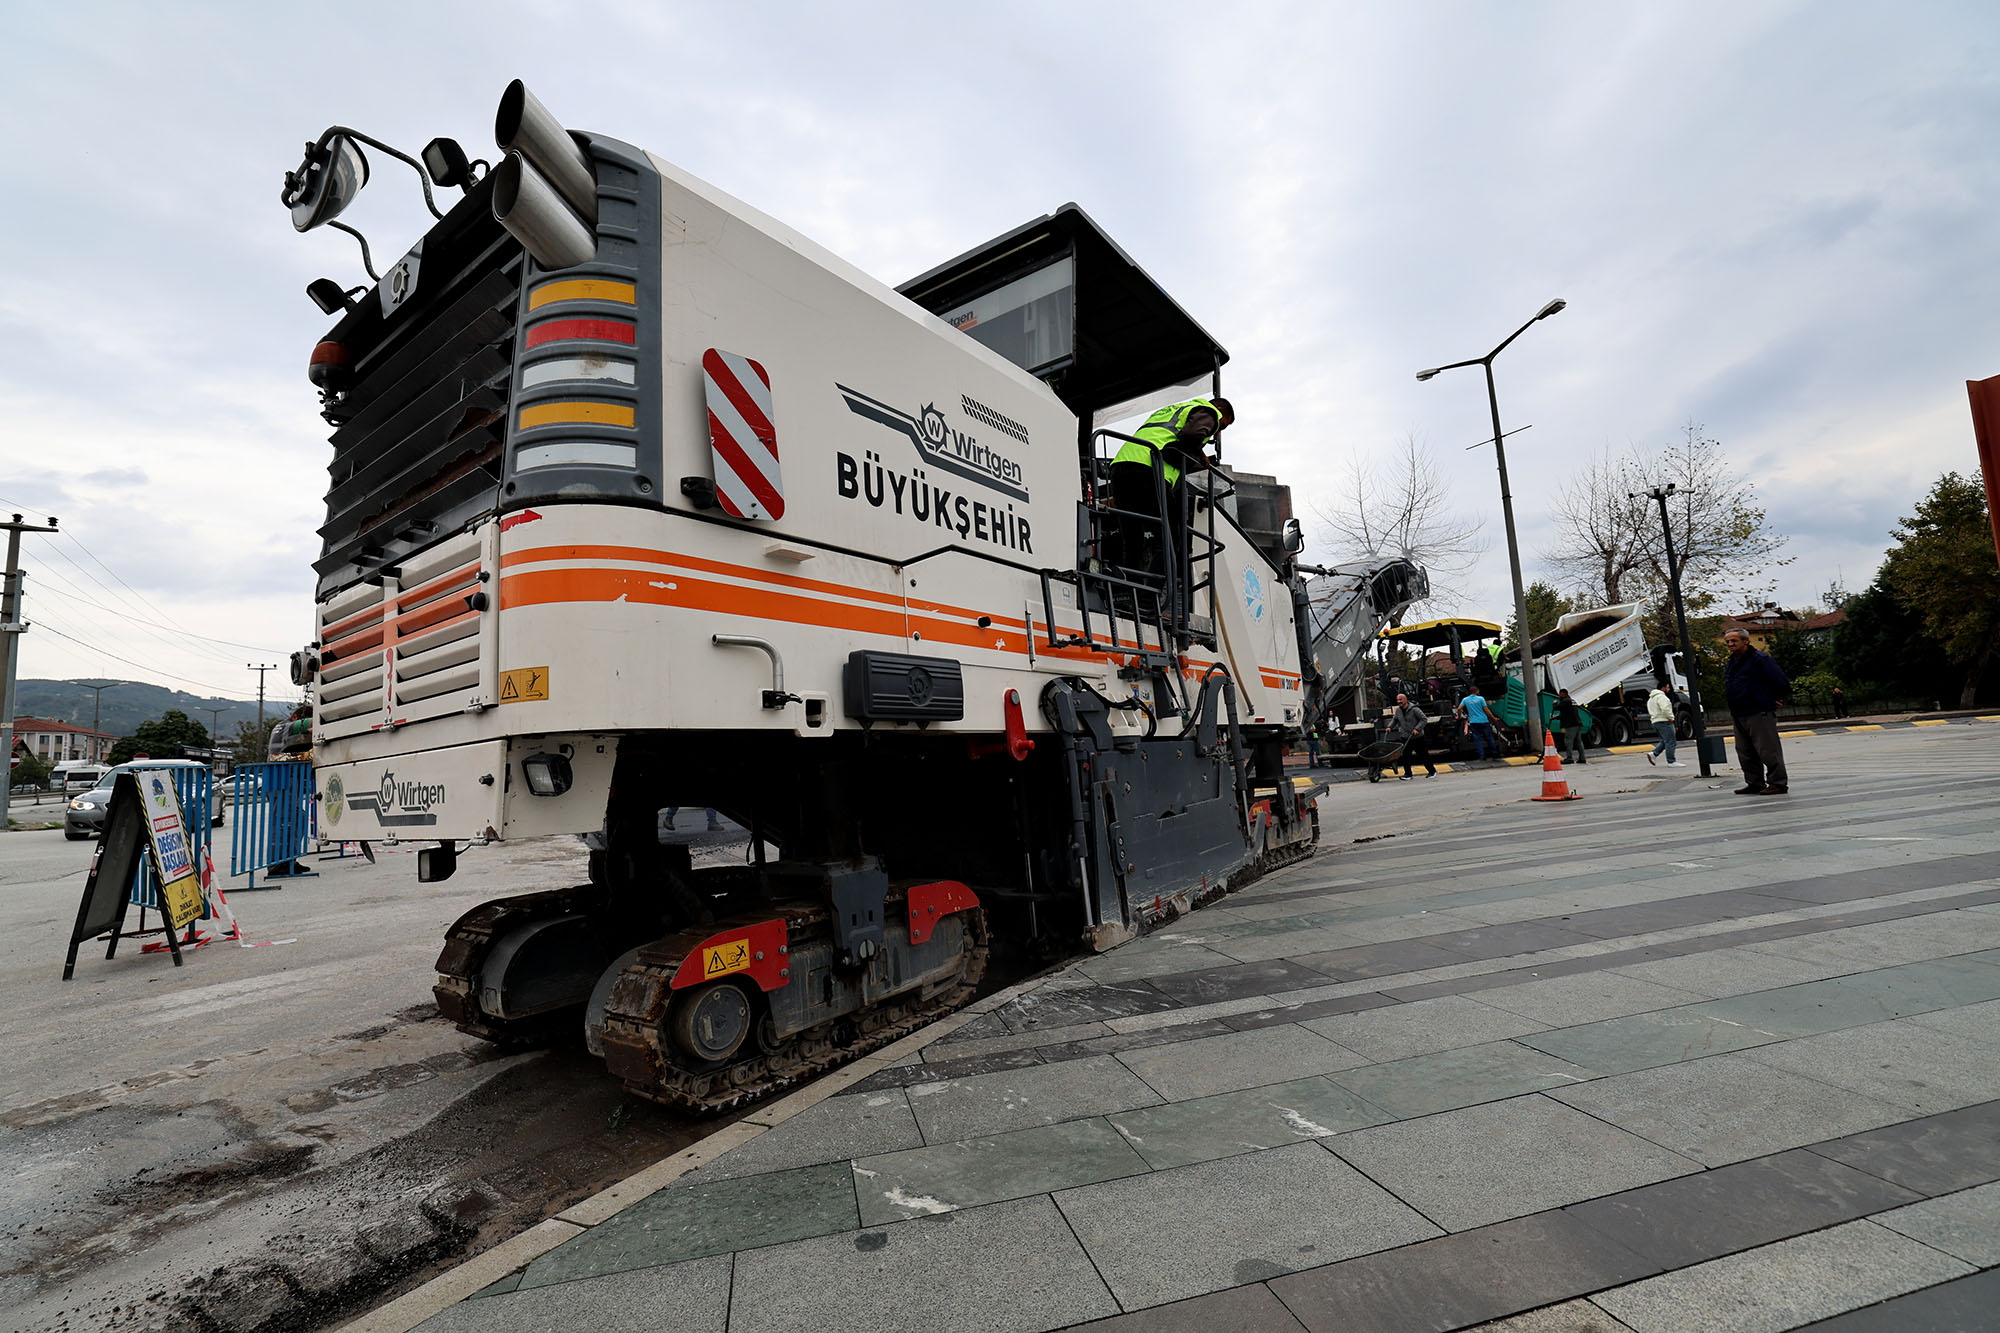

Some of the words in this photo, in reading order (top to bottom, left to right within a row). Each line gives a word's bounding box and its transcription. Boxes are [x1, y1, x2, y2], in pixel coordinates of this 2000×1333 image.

[952, 428, 1022, 482] Wirtgen
[837, 449, 1033, 554] BÜYÜKŞEHİR
[1572, 659, 1590, 675] SAKARYA
[397, 781, 446, 811] Wirtgen
